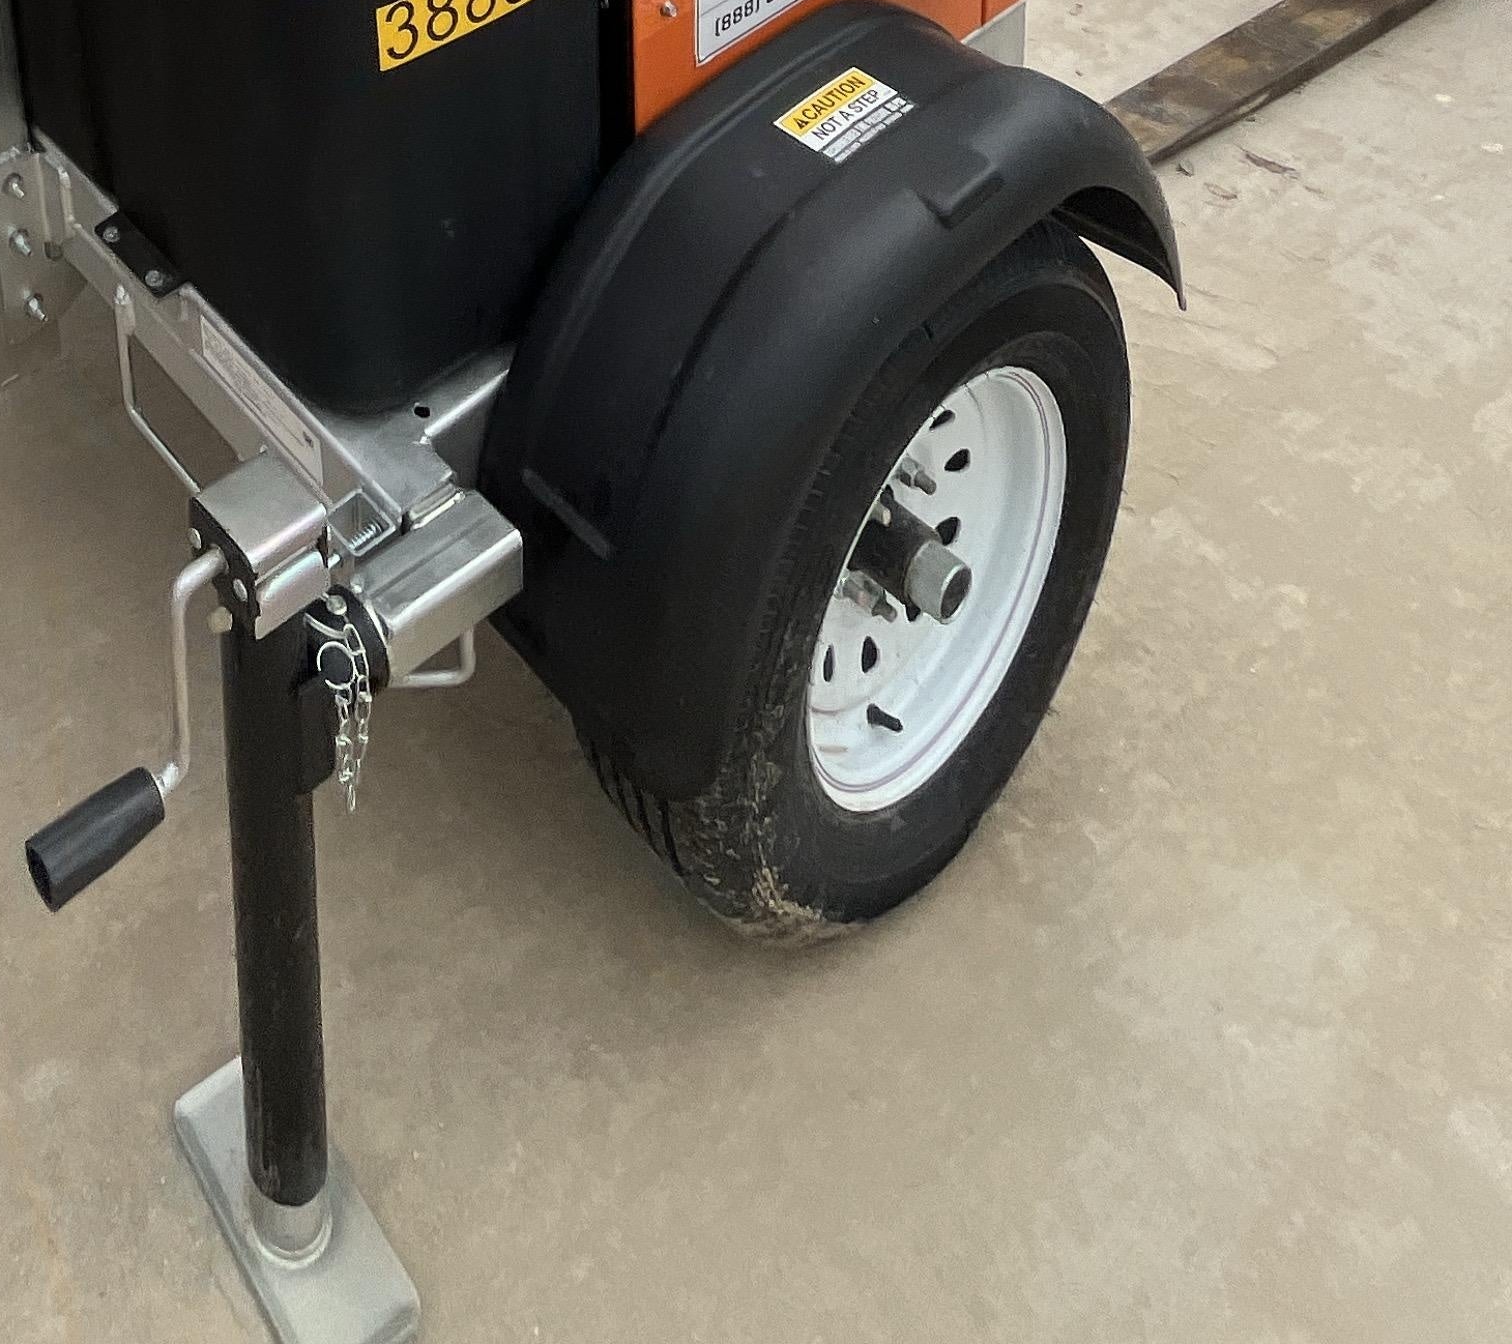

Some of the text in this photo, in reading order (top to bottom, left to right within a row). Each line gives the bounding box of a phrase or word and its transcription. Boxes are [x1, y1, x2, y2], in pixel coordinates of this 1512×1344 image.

[801, 75, 867, 121] CAUTION
[810, 89, 880, 141] NOT A STEP
